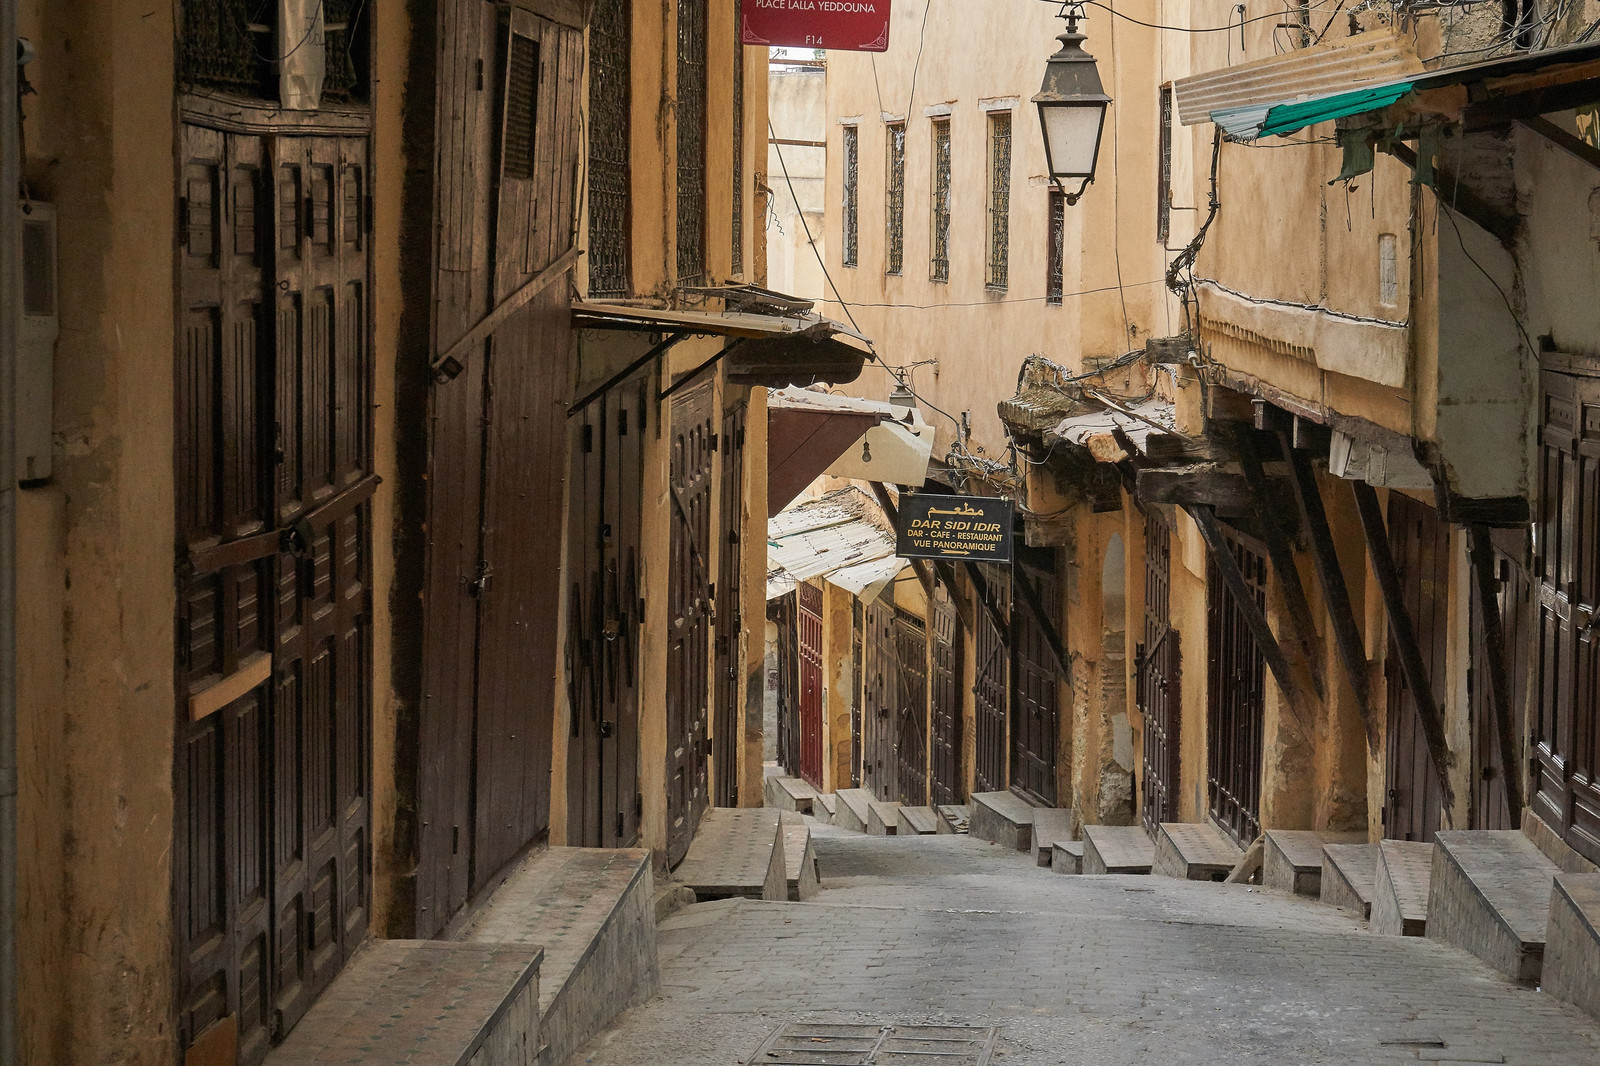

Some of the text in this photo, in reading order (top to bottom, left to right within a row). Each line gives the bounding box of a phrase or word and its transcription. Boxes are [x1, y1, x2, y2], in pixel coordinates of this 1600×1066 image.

[756, 0, 876, 13] PLACE LALLA YEDDOUNA
[805, 35, 823, 45] F14
[927, 502, 984, 519] مطعم
[911, 519, 1001, 532] DAR SIDI IDIR
[907, 529, 924, 537] DAR
[930, 530, 951, 539] CAFE
[957, 532, 1003, 542] RESTAURANT
[913, 539, 996, 551] VUE PANORAMIQUE
